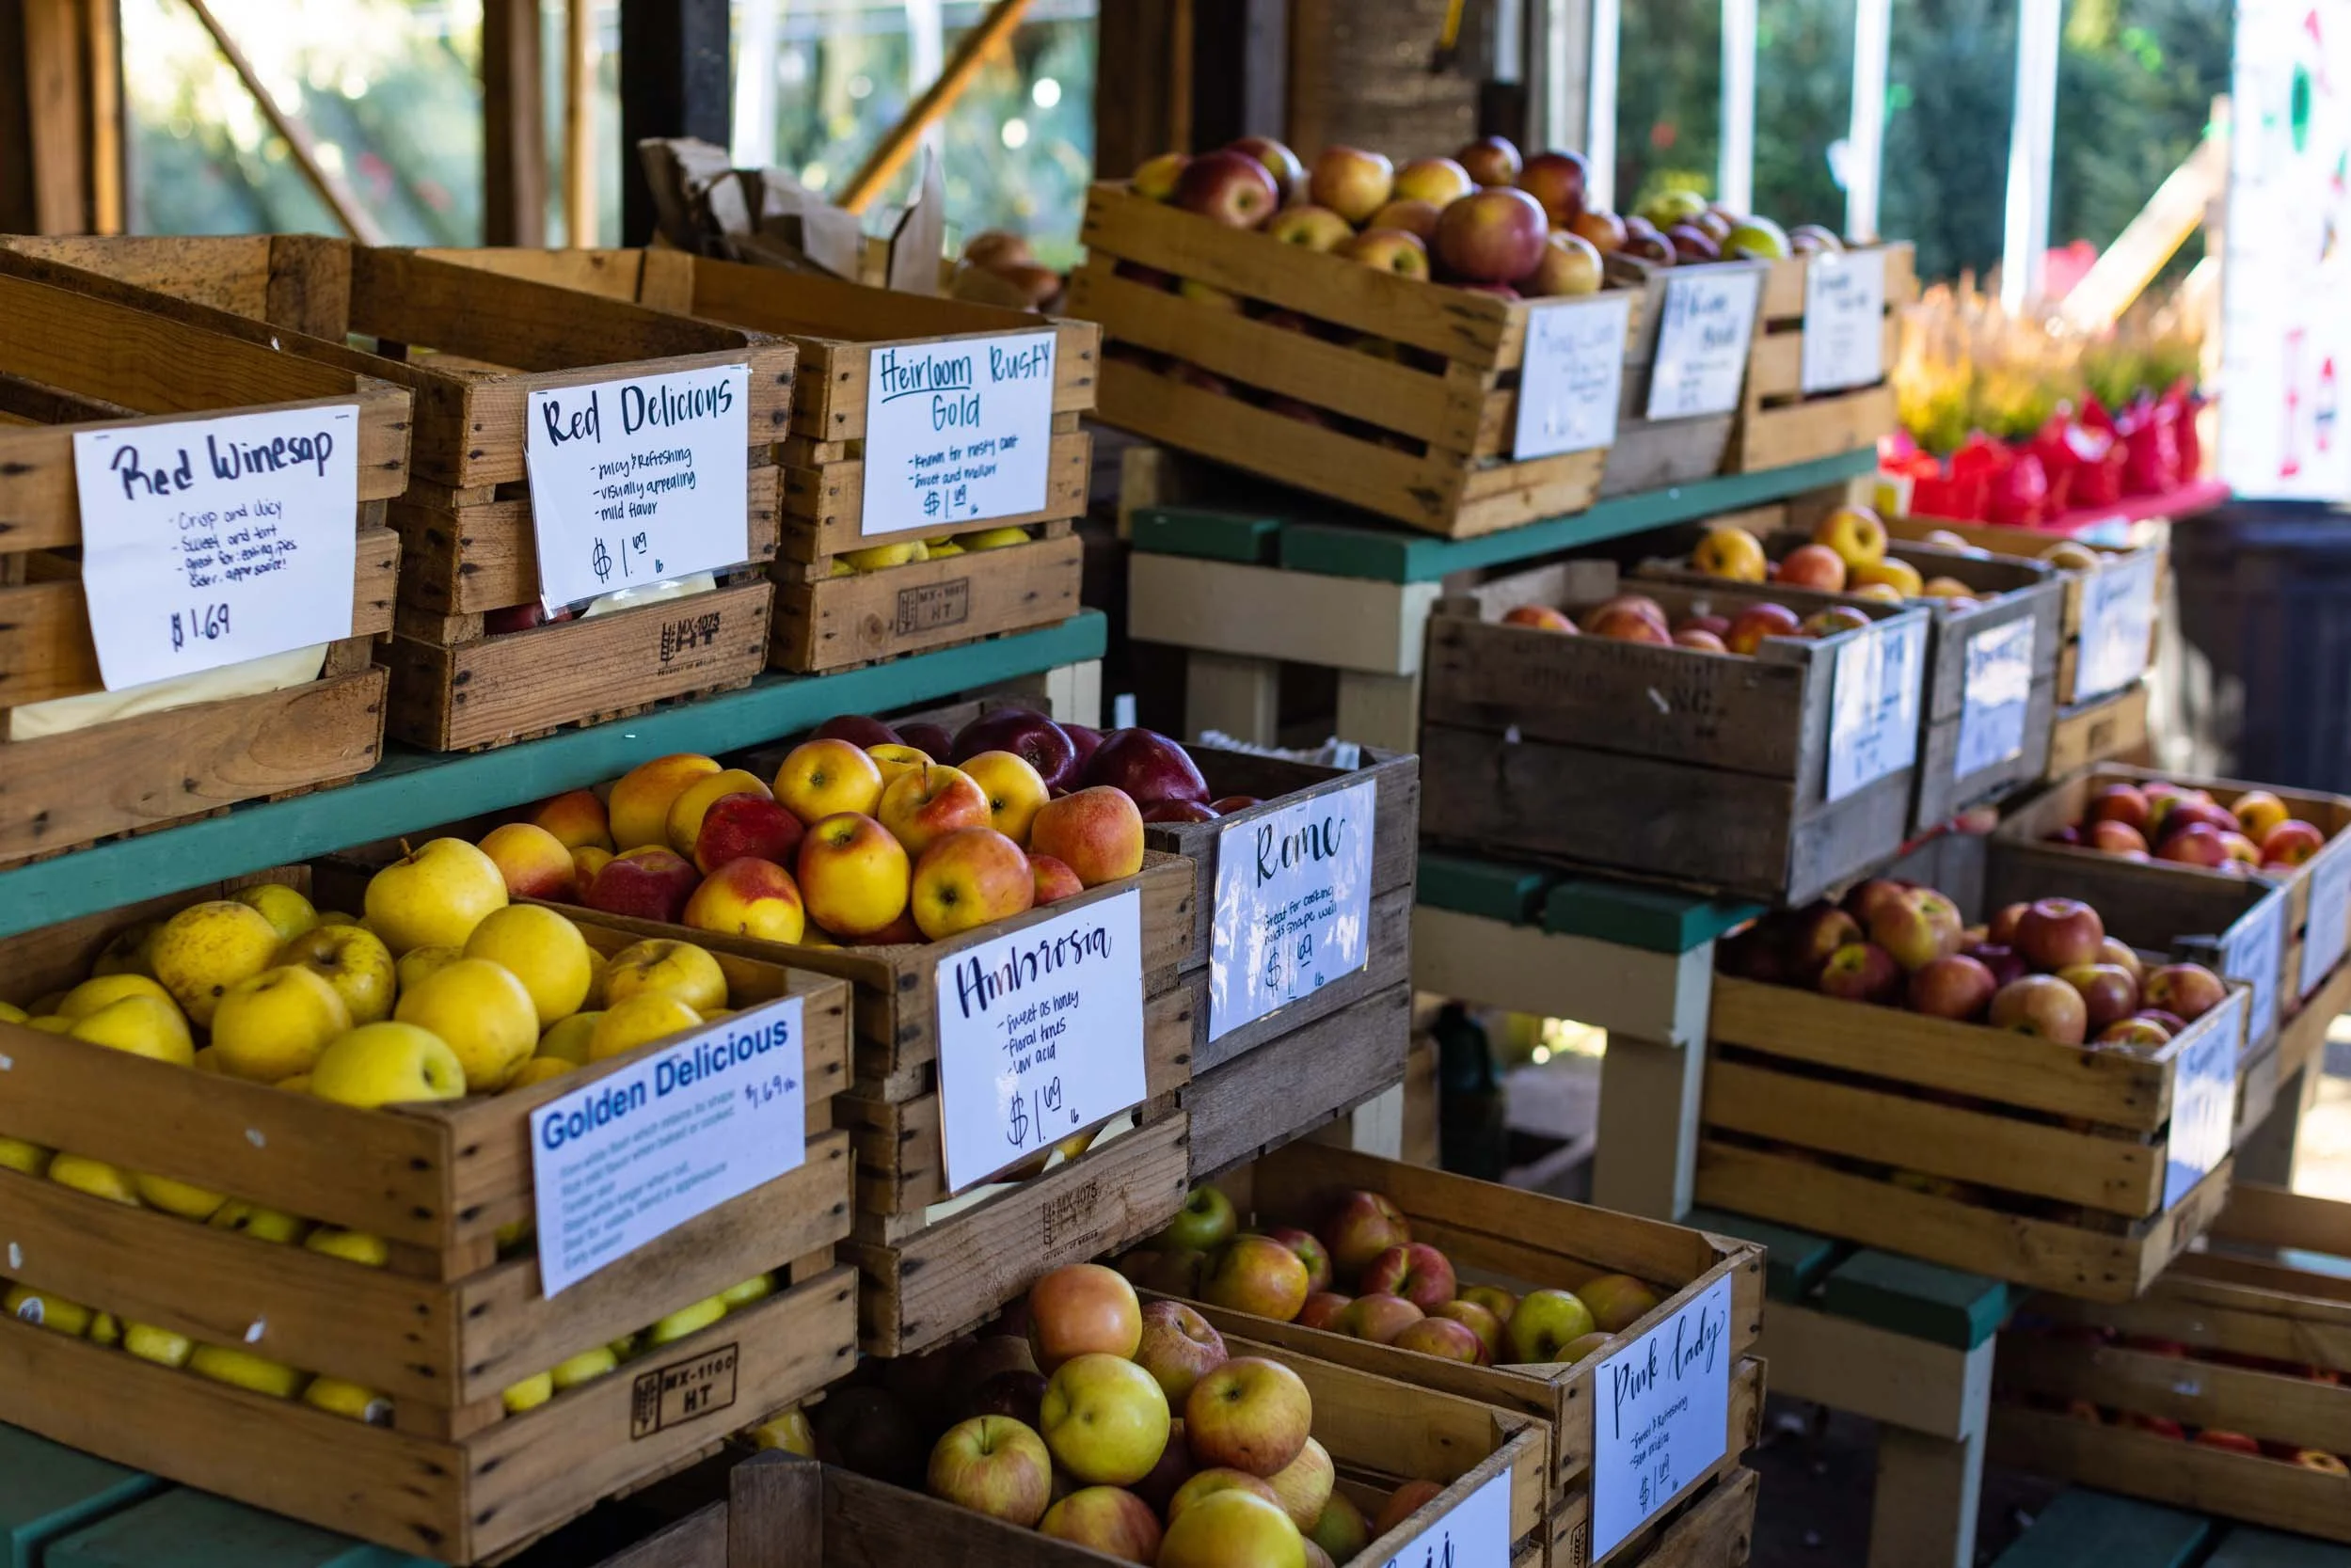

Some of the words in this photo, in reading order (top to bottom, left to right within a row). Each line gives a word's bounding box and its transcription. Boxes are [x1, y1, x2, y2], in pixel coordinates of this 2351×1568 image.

[880, 349, 973, 393] Heirloom
[542, 389, 601, 447] Red
[620, 377, 733, 436] Delicious
[931, 392, 980, 432] Gold
[110, 444, 194, 500] Red
[205, 430, 334, 483] Winesap
[646, 470, 696, 495] appealing
[942, 467, 961, 483] and
[178, 511, 218, 530] Crisp
[224, 503, 248, 523] and
[627, 501, 659, 518] flavor
[227, 528, 251, 546] and
[1256, 816, 1346, 889] Rome
[955, 922, 1113, 1019] Ambrosia
[1040, 1000, 1051, 1018] as
[1053, 990, 1079, 1012] honey
[1035, 1040, 1056, 1064] acid
[541, 1080, 648, 1151] Golden
[654, 1019, 789, 1099] Delicious
[683, 1383, 713, 1415] HT
[1612, 1337, 1660, 1440] Pink
